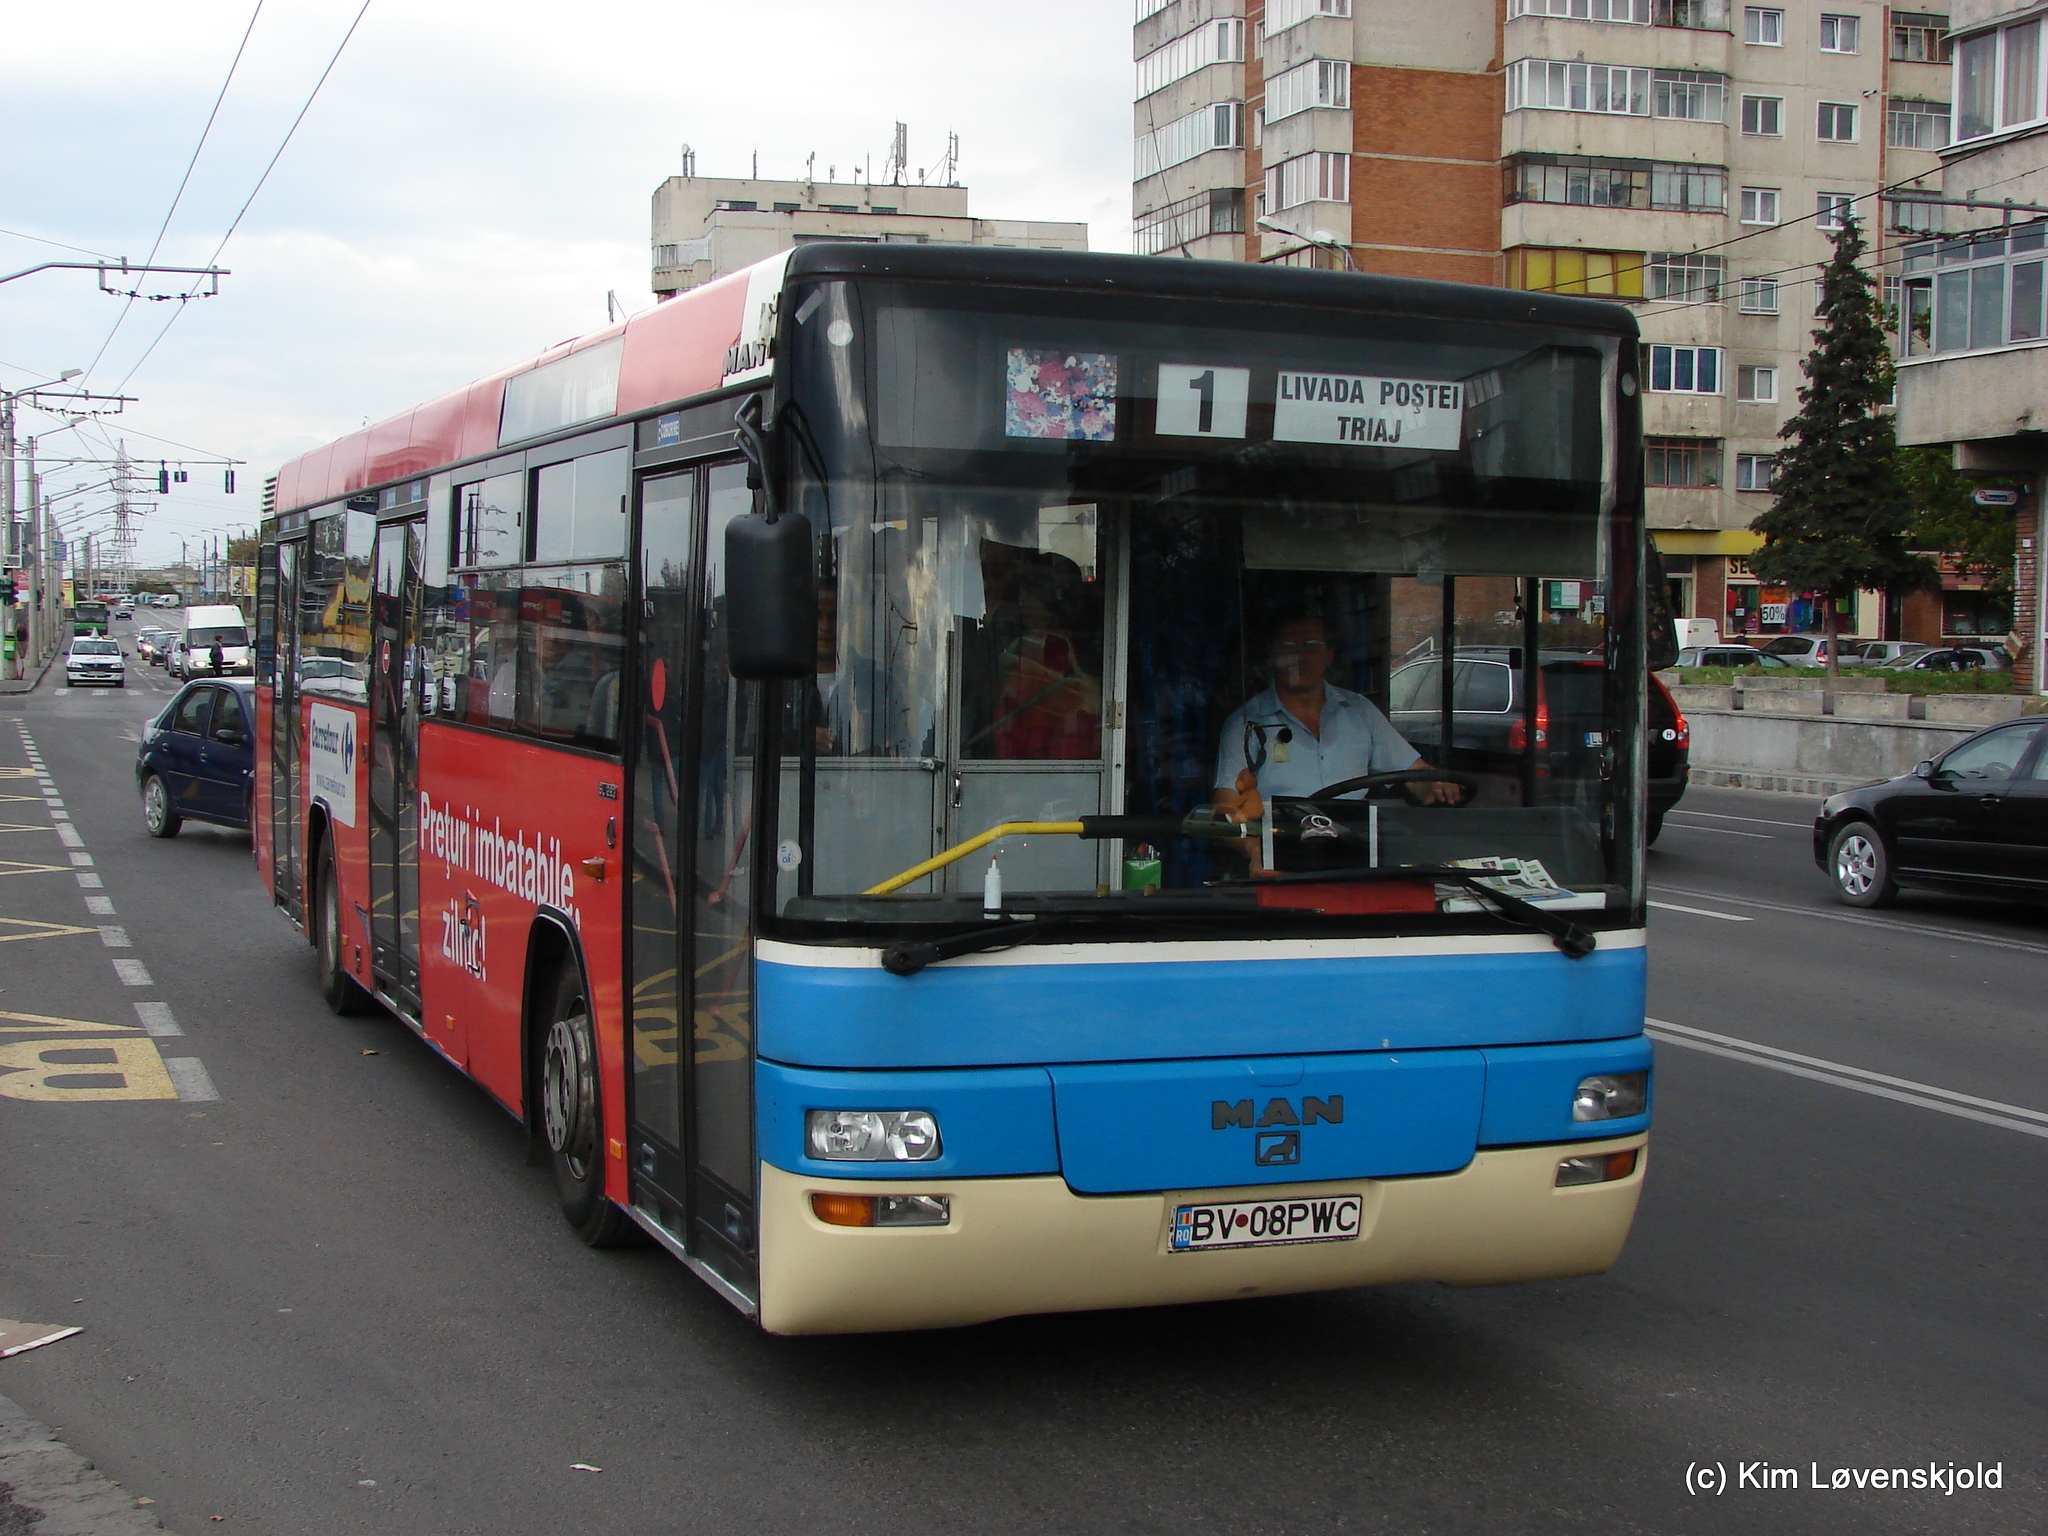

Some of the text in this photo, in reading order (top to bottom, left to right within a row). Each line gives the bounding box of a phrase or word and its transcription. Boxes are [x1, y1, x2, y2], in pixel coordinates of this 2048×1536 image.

[722, 341, 766, 377] MAN
[1189, 370, 1214, 432] 1
[1281, 375, 1365, 404] LIVADA
[1337, 416, 1402, 443] TRIAJ
[1730, 559, 1758, 574] SE
[1762, 606, 1785, 621] 50%
[1211, 1095, 1344, 1130] MAN
